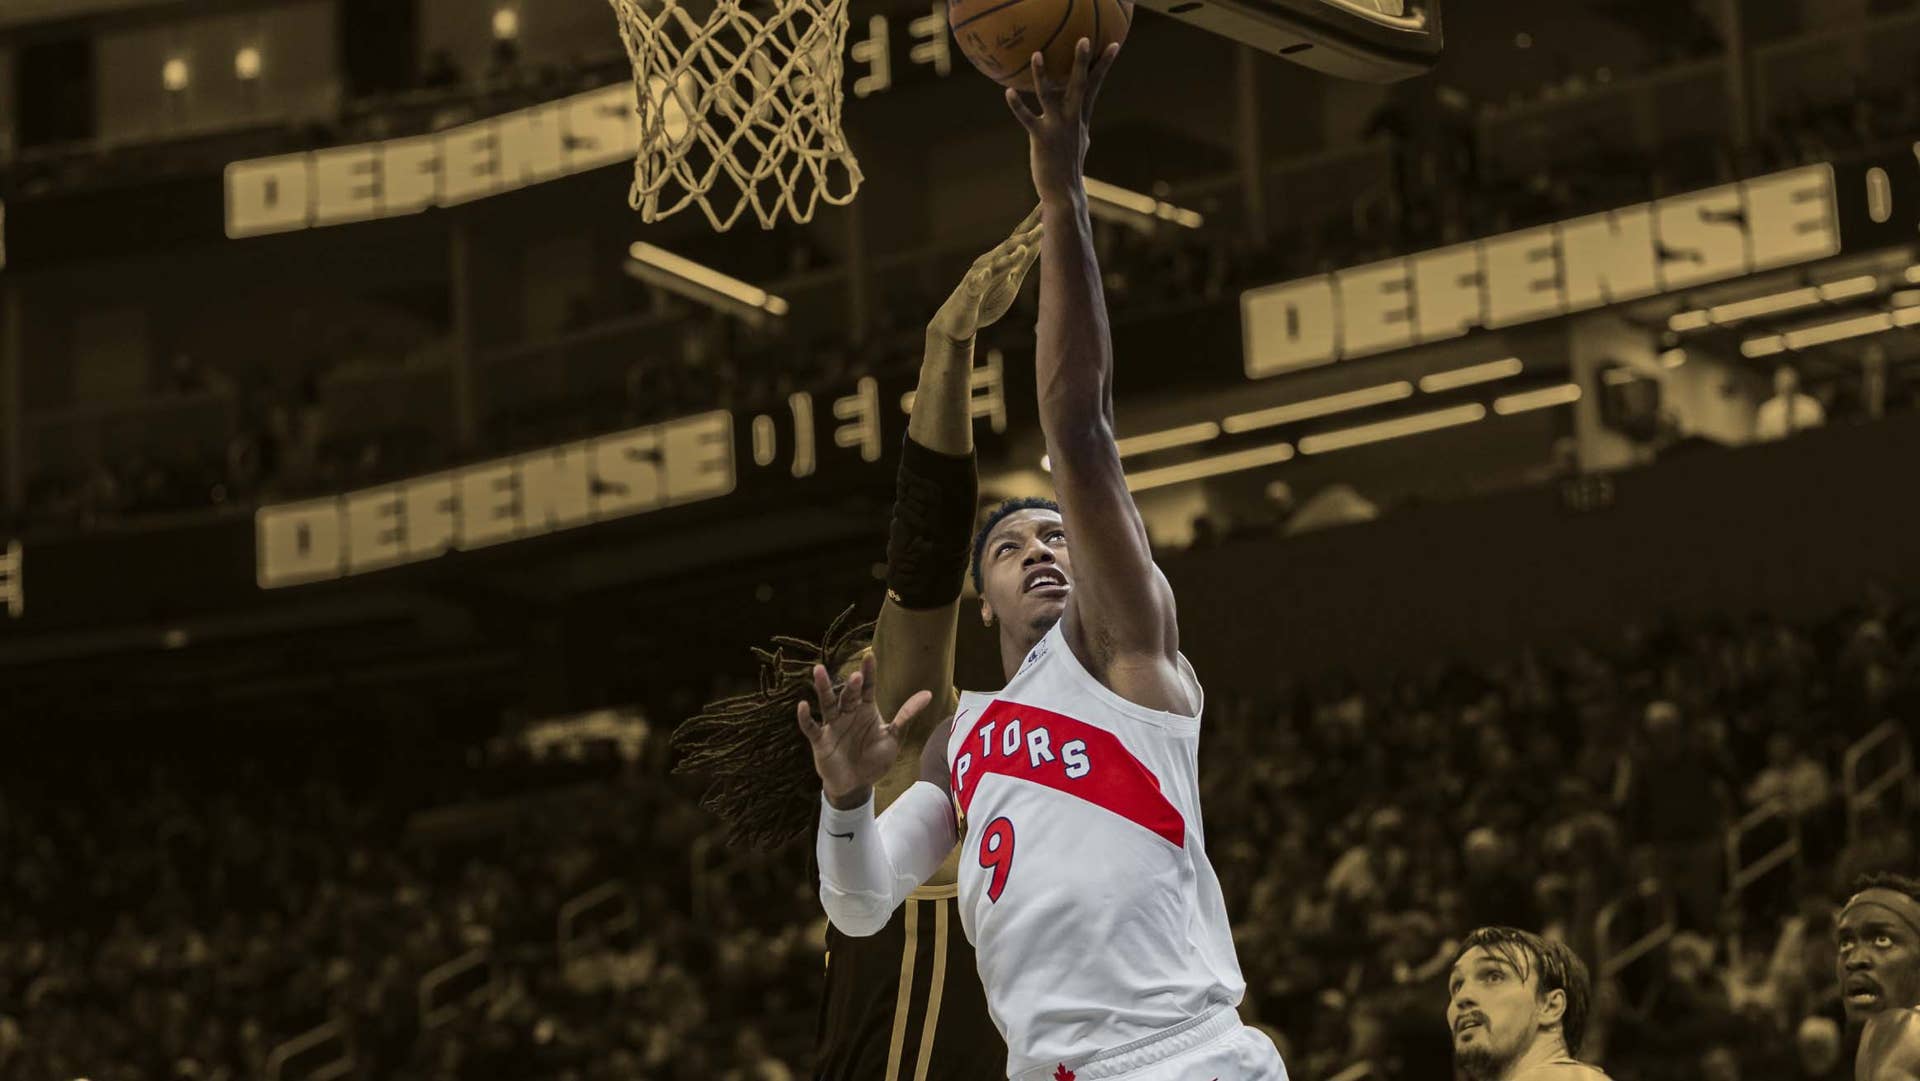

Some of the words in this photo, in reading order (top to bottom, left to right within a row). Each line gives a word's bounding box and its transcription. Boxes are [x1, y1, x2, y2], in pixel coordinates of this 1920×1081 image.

[1241, 163, 1841, 377] DEFENSE
[257, 409, 734, 588] DEFENSE
[978, 816, 1016, 904] 9
